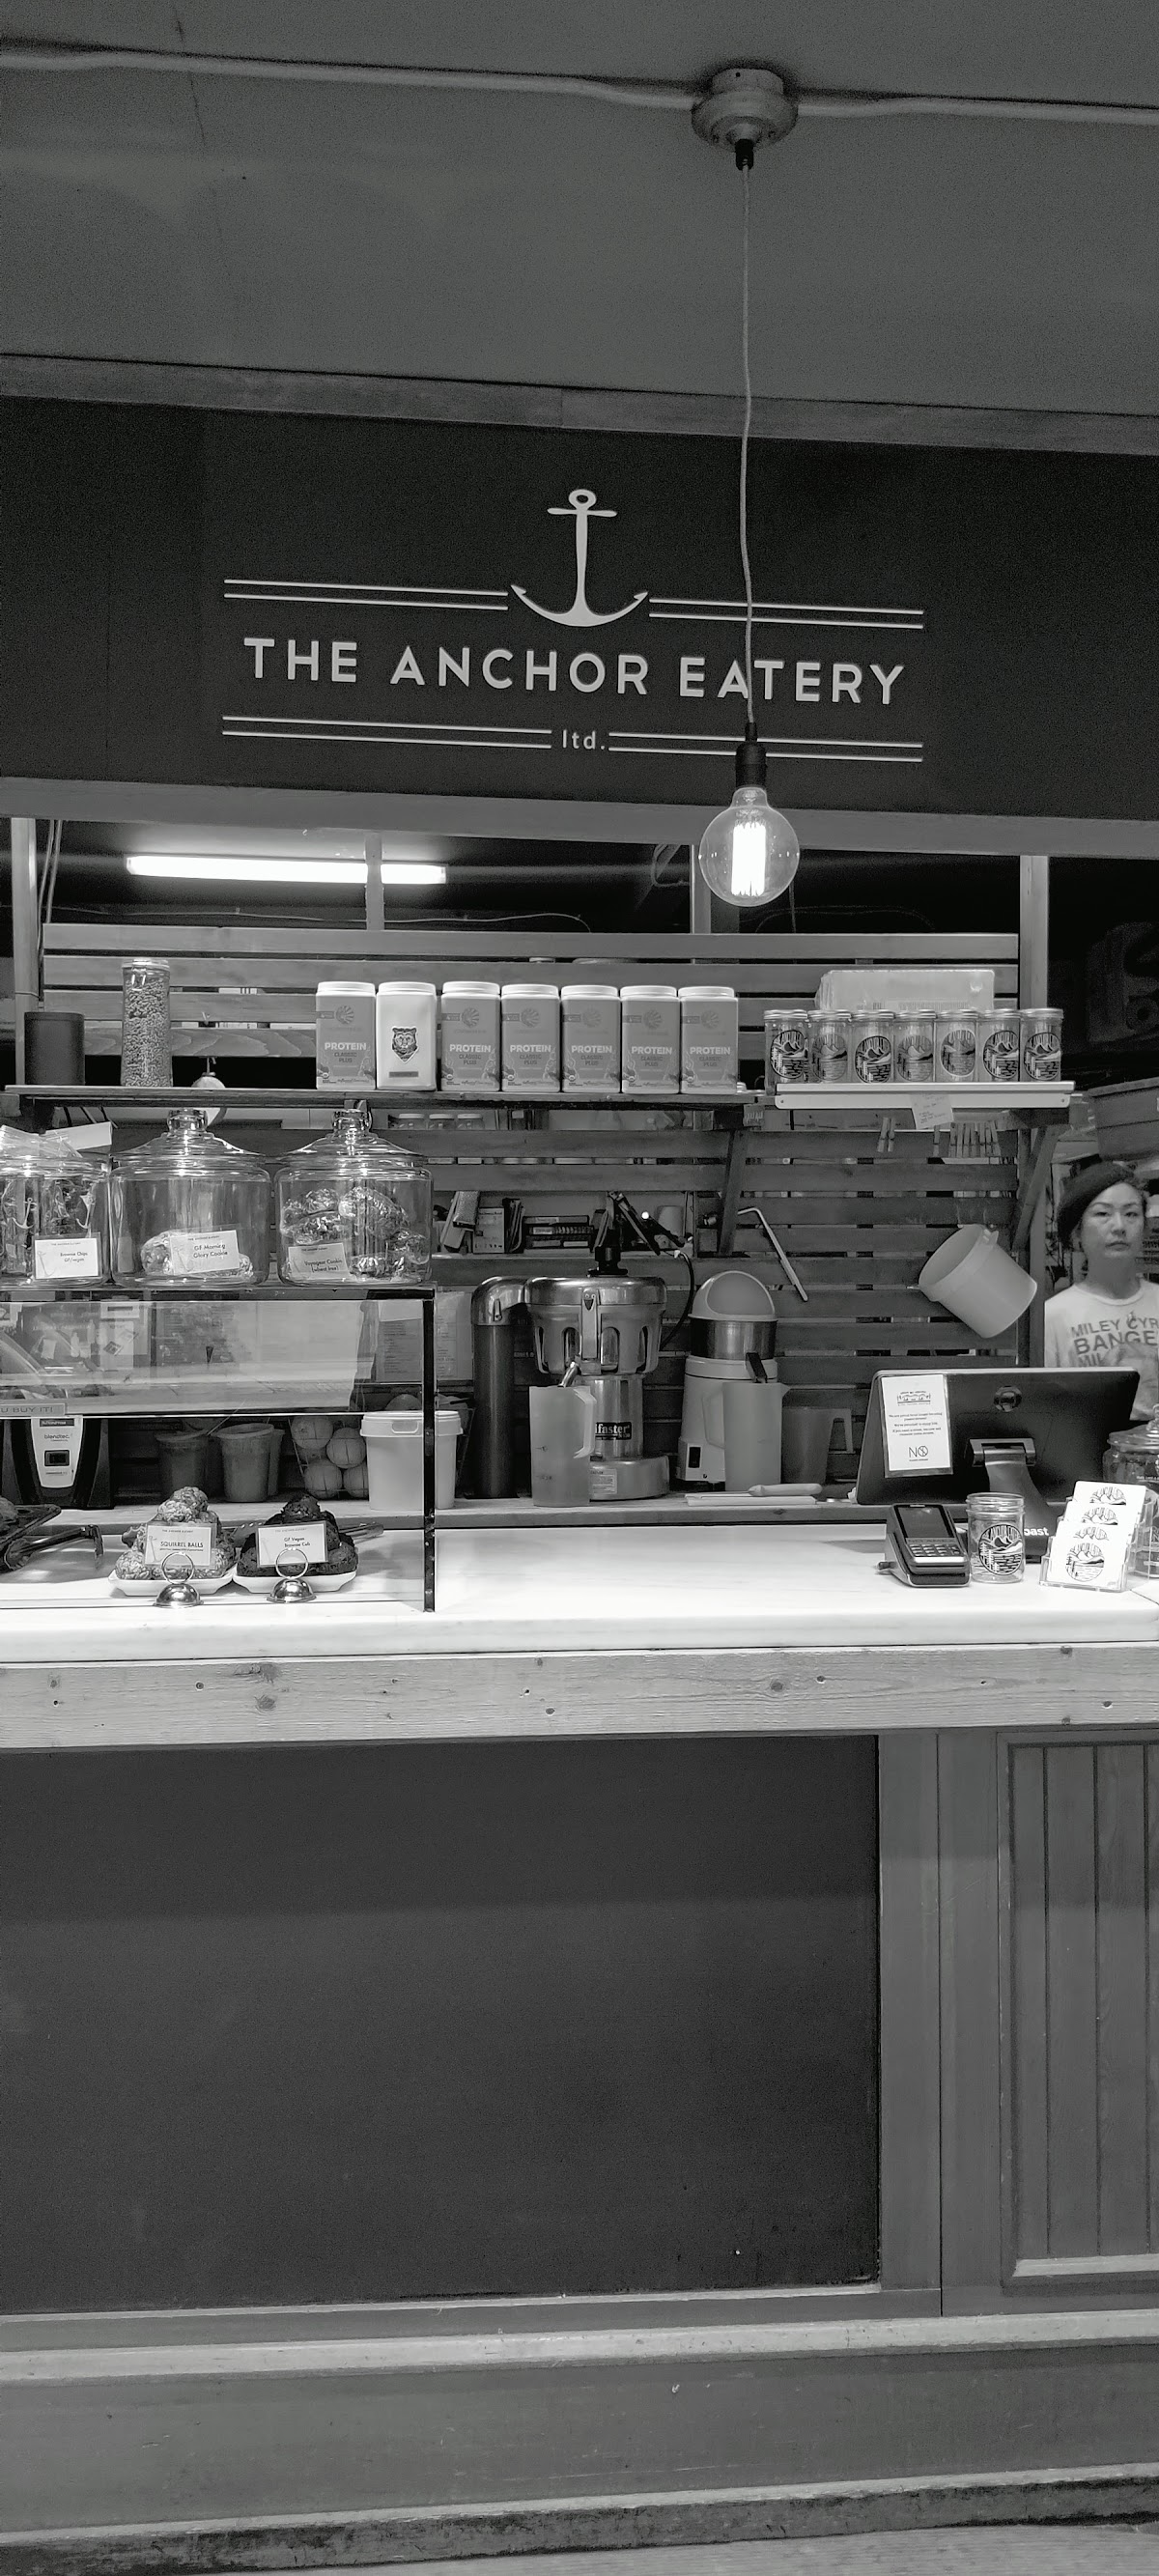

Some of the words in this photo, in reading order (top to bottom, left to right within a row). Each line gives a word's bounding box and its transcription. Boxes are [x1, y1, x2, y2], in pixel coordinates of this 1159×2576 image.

[244, 637, 357, 683] THE
[389, 645, 648, 694] ANCHOR
[679, 657, 904, 705] EATERY
[562, 729, 606, 750] ltd.
[325, 1042, 367, 1051] PROTEIN
[449, 1044, 492, 1053] PROTEIN
[510, 1044, 551, 1053] PROTEIN
[571, 1045, 613, 1054] PROTEIN
[631, 1046, 673, 1055] PROTEIN
[690, 1046, 731, 1055] PROTEIN
[1071, 1318, 1120, 1337] MILEY
[1074, 1330, 1158, 1354] BANGE
